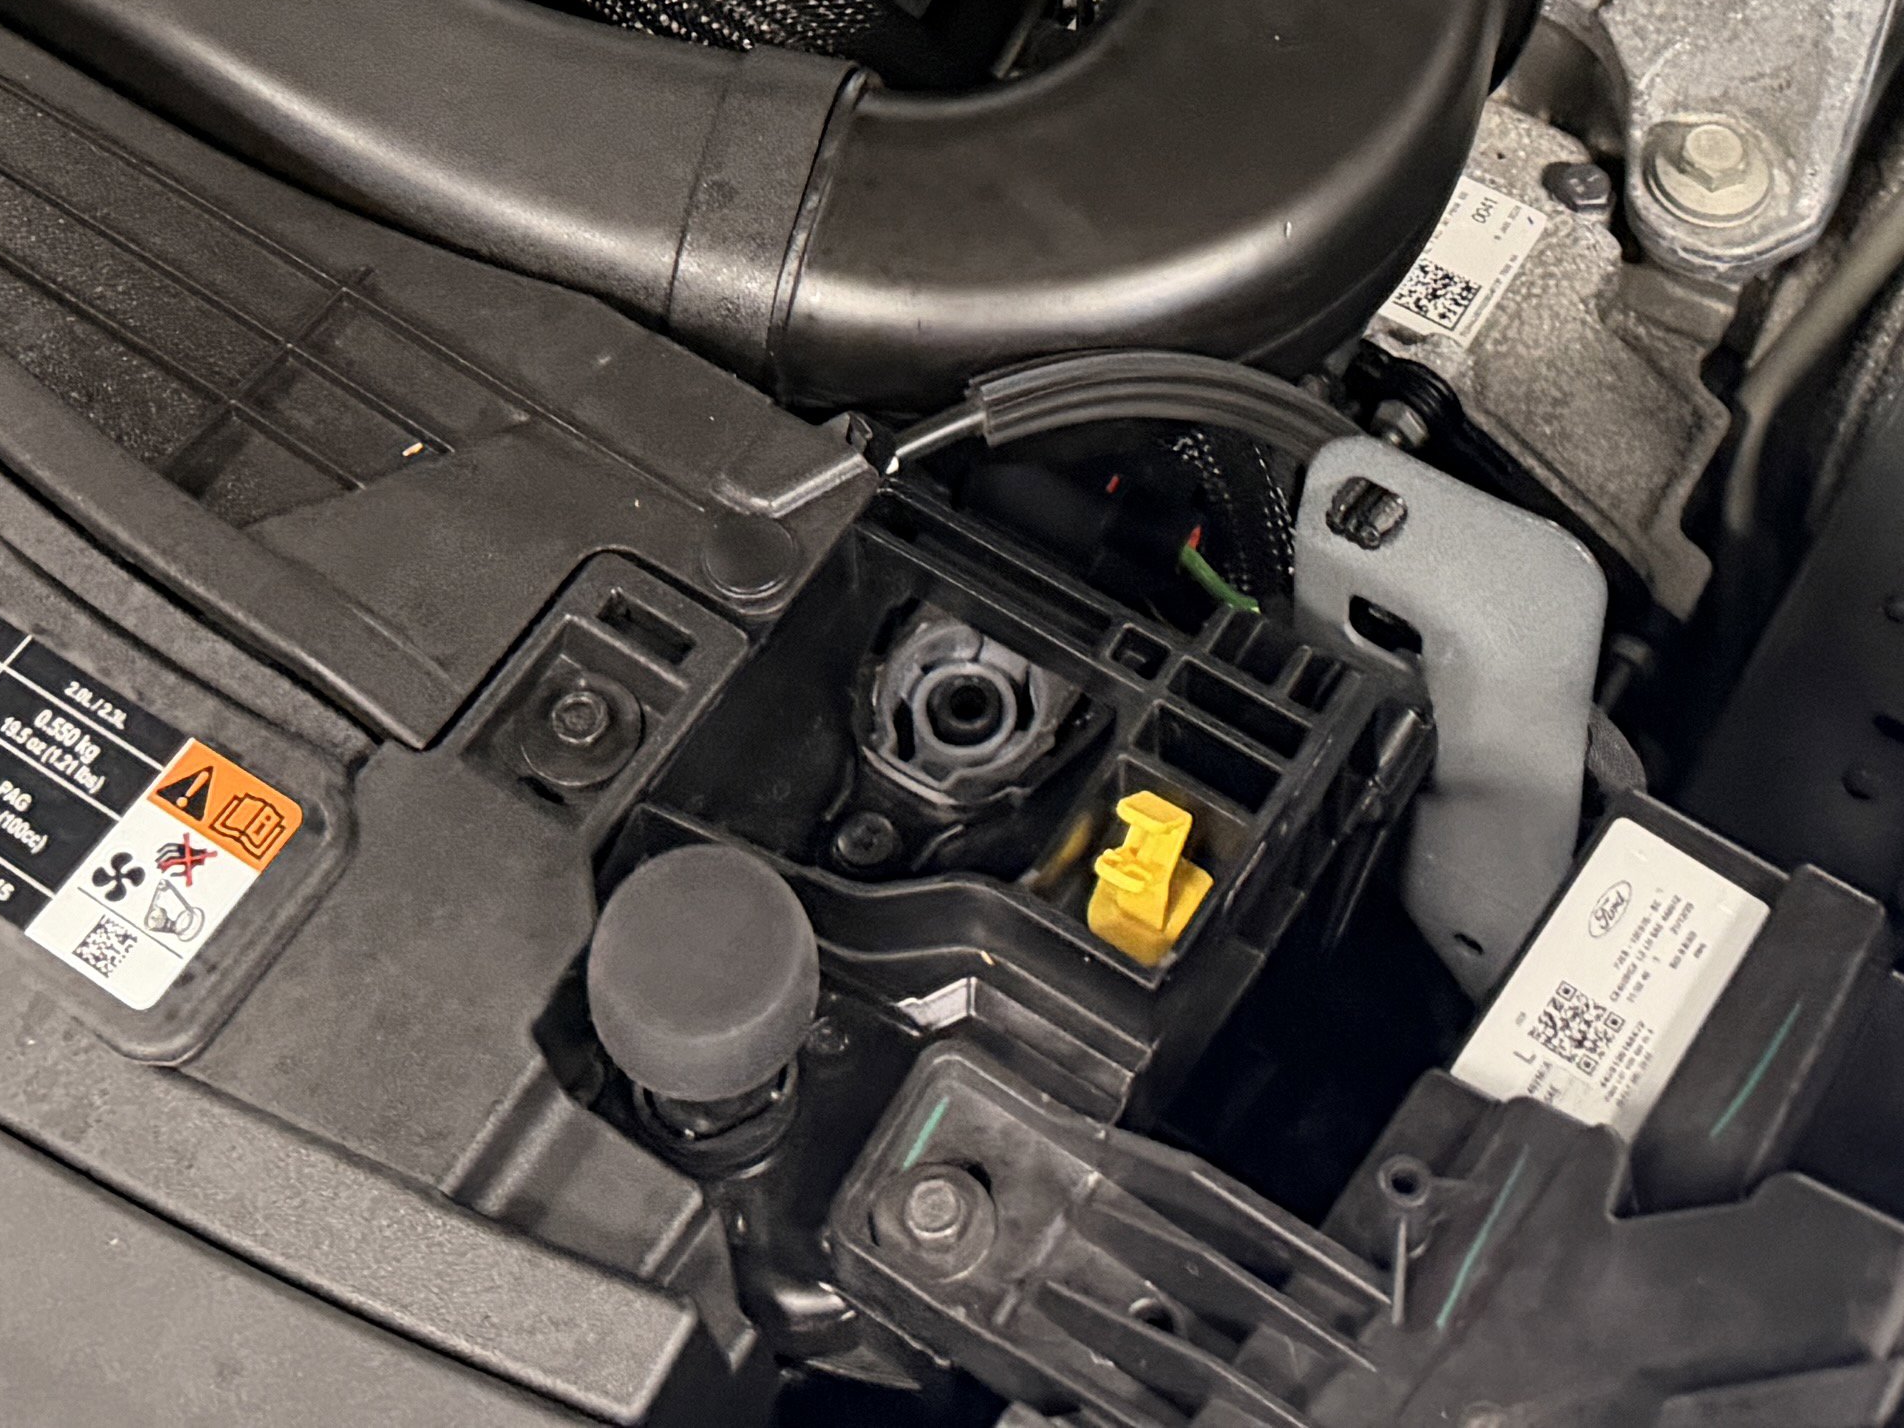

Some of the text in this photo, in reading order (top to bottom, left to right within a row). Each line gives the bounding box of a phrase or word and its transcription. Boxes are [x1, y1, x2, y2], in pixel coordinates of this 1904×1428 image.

[1472, 196, 1499, 225] 0041
[63, 680, 93, 709] 2.0L
[0, 716, 106, 795] 19.5 oz (1.21 lbs)
[33, 708, 101, 770] 0.550 kg
